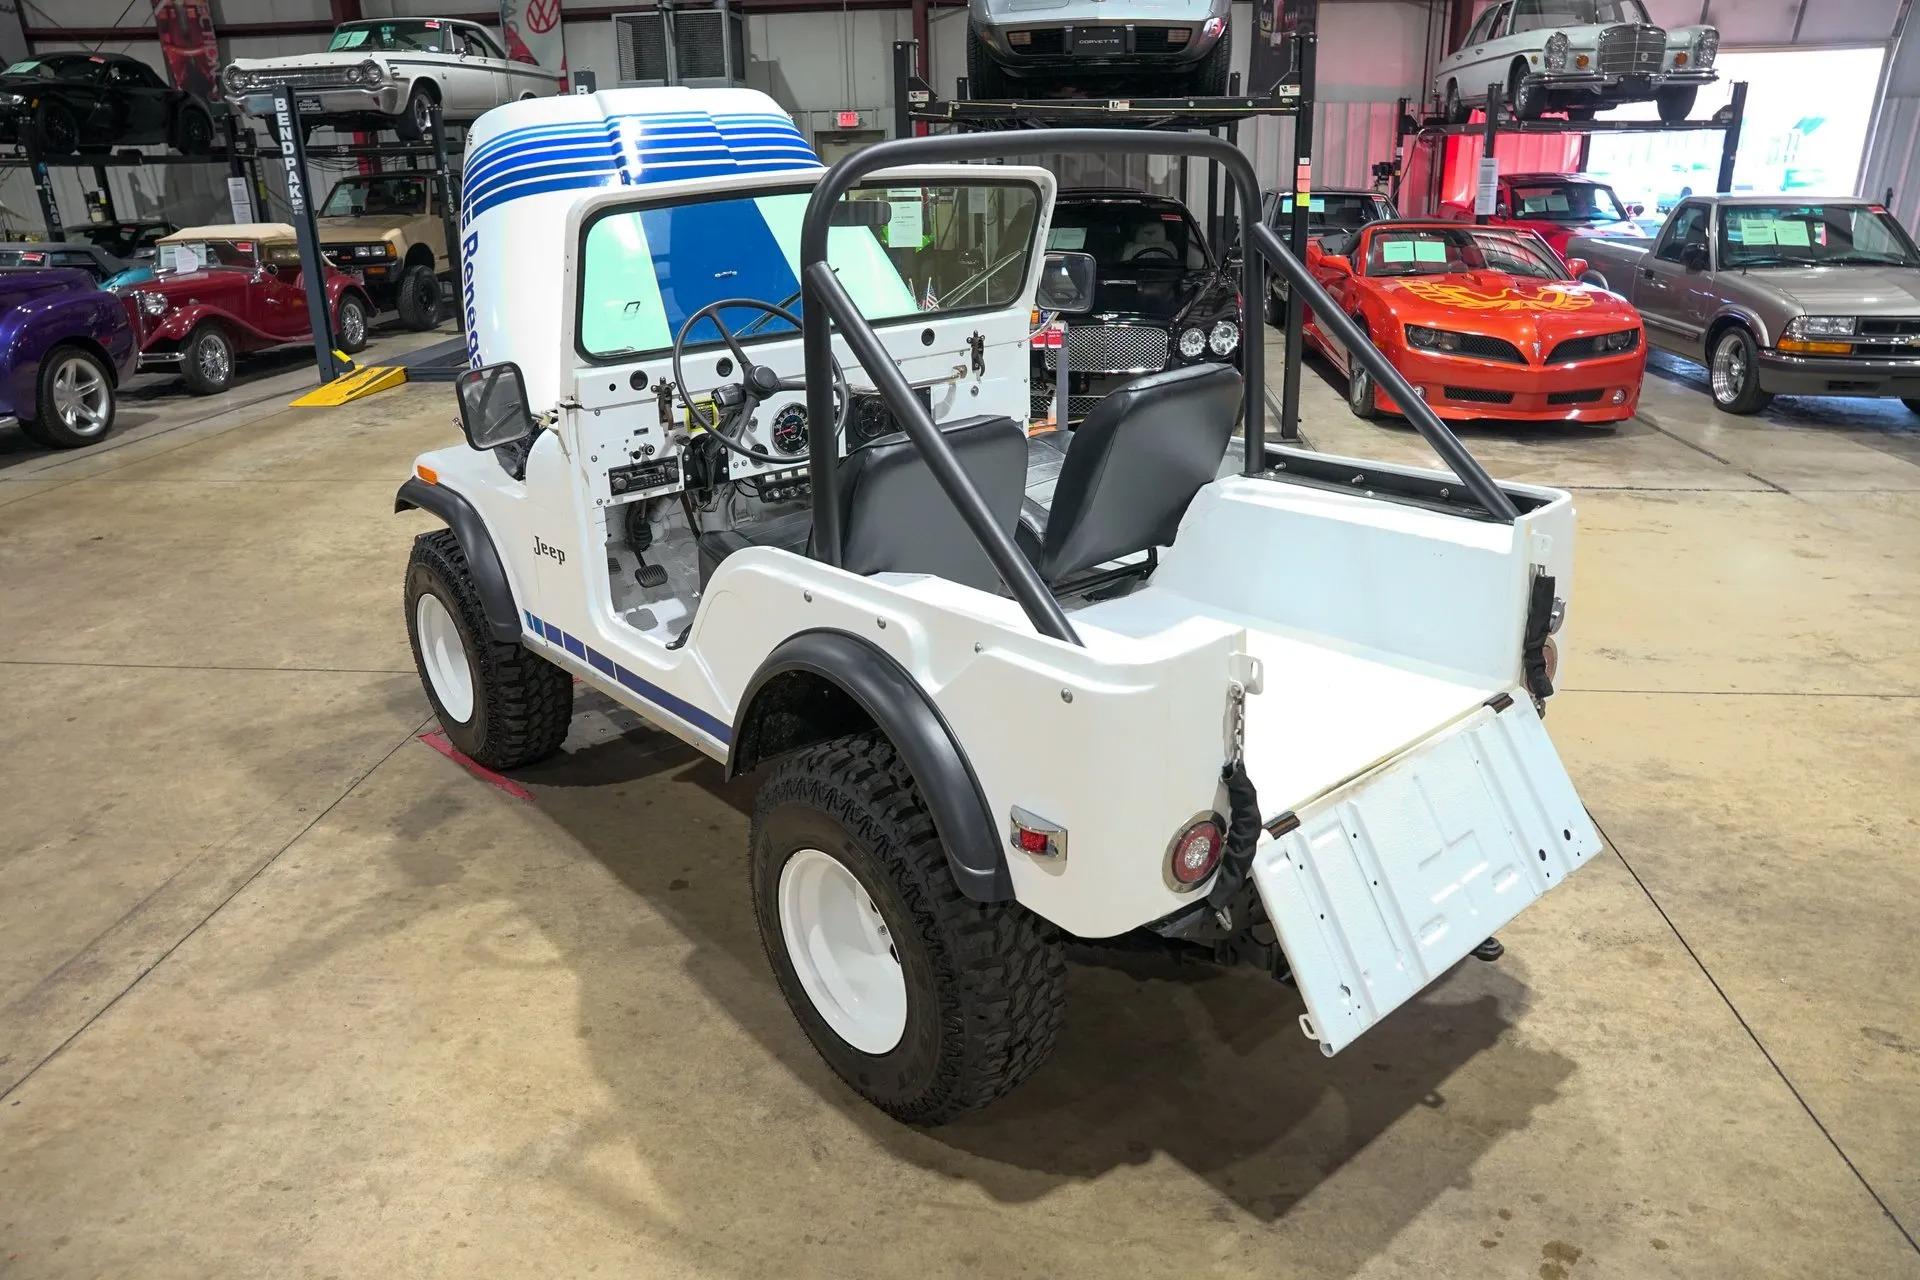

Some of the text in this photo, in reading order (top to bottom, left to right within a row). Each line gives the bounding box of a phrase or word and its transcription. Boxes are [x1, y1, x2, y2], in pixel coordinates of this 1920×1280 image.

[274, 97, 303, 198] BENDPAK
[43, 175, 60, 224] ATLAS
[443, 163, 455, 213] ATLAS
[533, 535, 566, 566] Jeep
